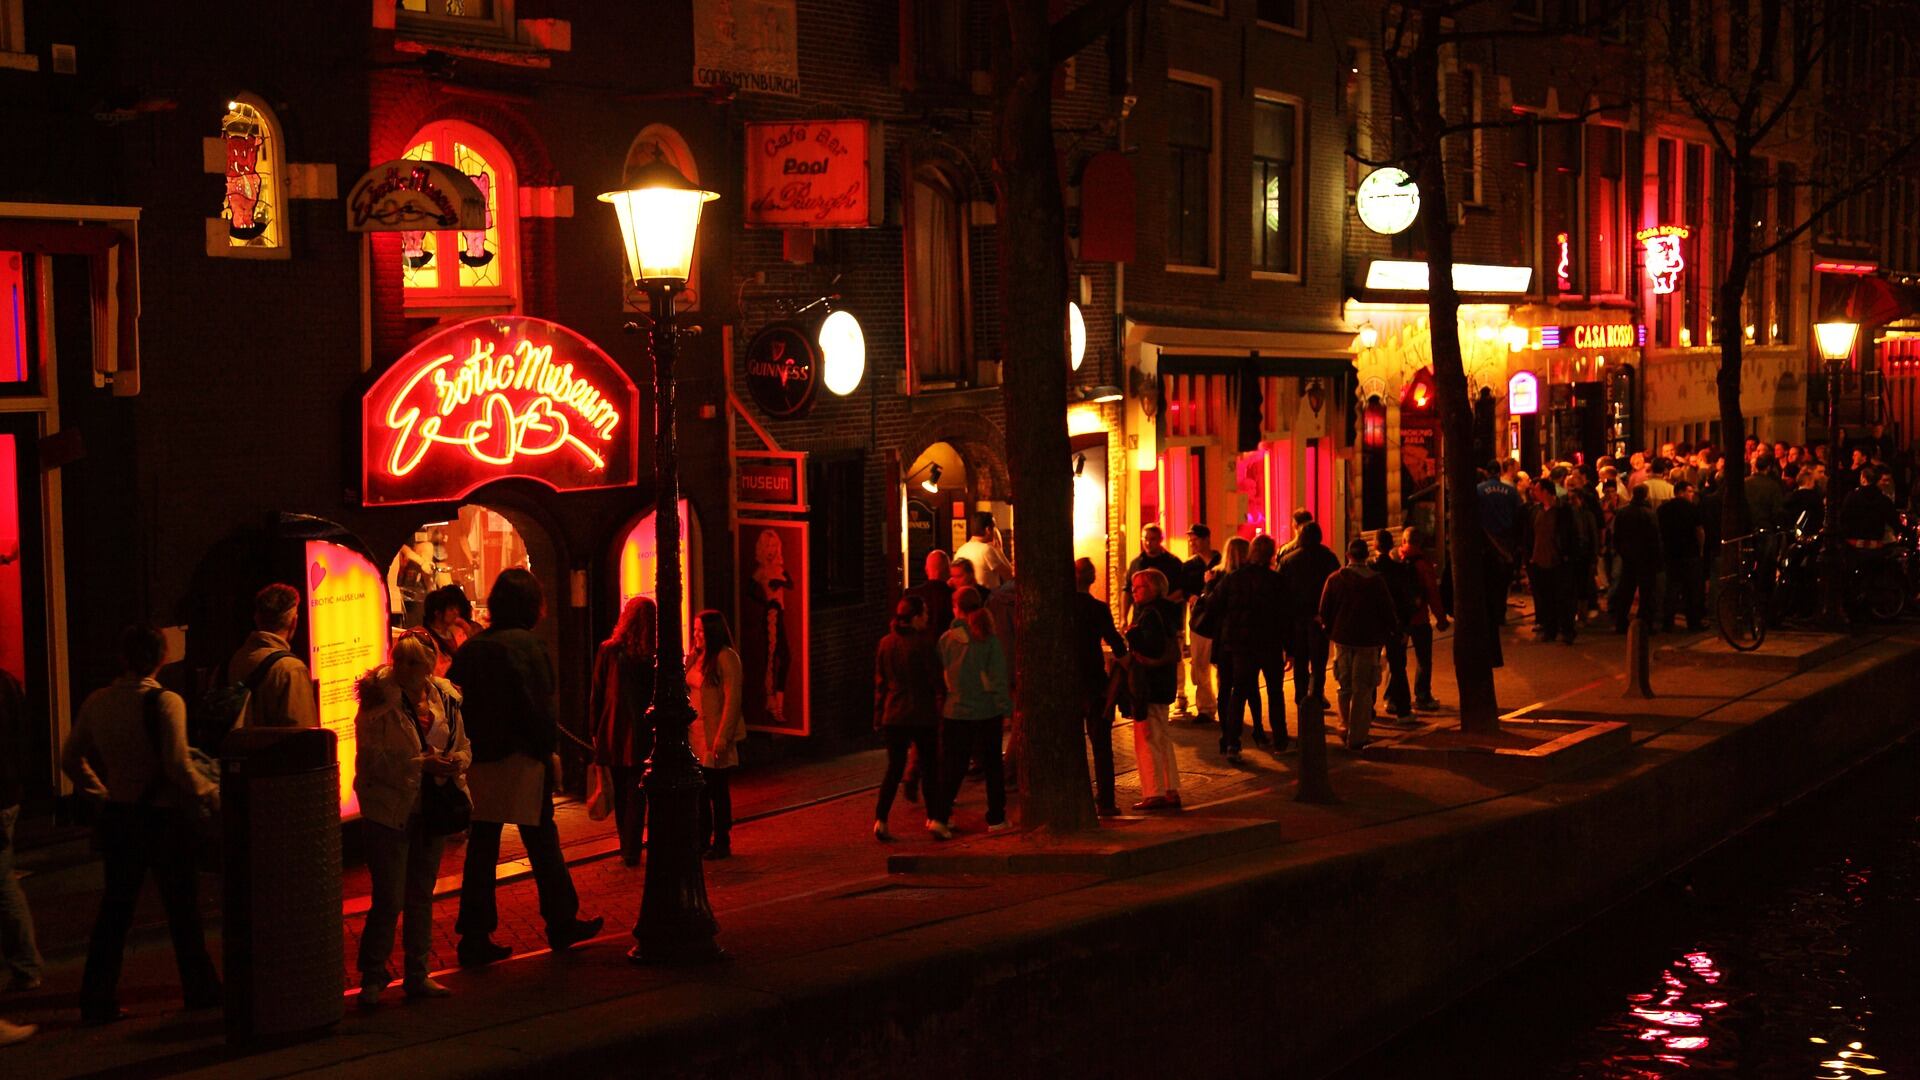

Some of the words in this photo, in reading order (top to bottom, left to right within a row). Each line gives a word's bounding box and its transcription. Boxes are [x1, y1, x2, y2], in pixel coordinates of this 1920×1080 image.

[816, 127, 848, 156] Bar
[783, 157, 829, 175] Pool
[1636, 227, 1659, 241] CASA
[1660, 225, 1689, 239] ROSSO
[1574, 325, 1606, 349] CASA
[1607, 324, 1634, 348] ROSSO
[748, 360, 809, 381] GUINNESS
[386, 337, 515, 476] Erotic
[515, 339, 620, 441] Museum
[741, 475, 789, 490] MUSEUM
[311, 595, 334, 607] EROTIC
[336, 592, 366, 603] MUSEUM
